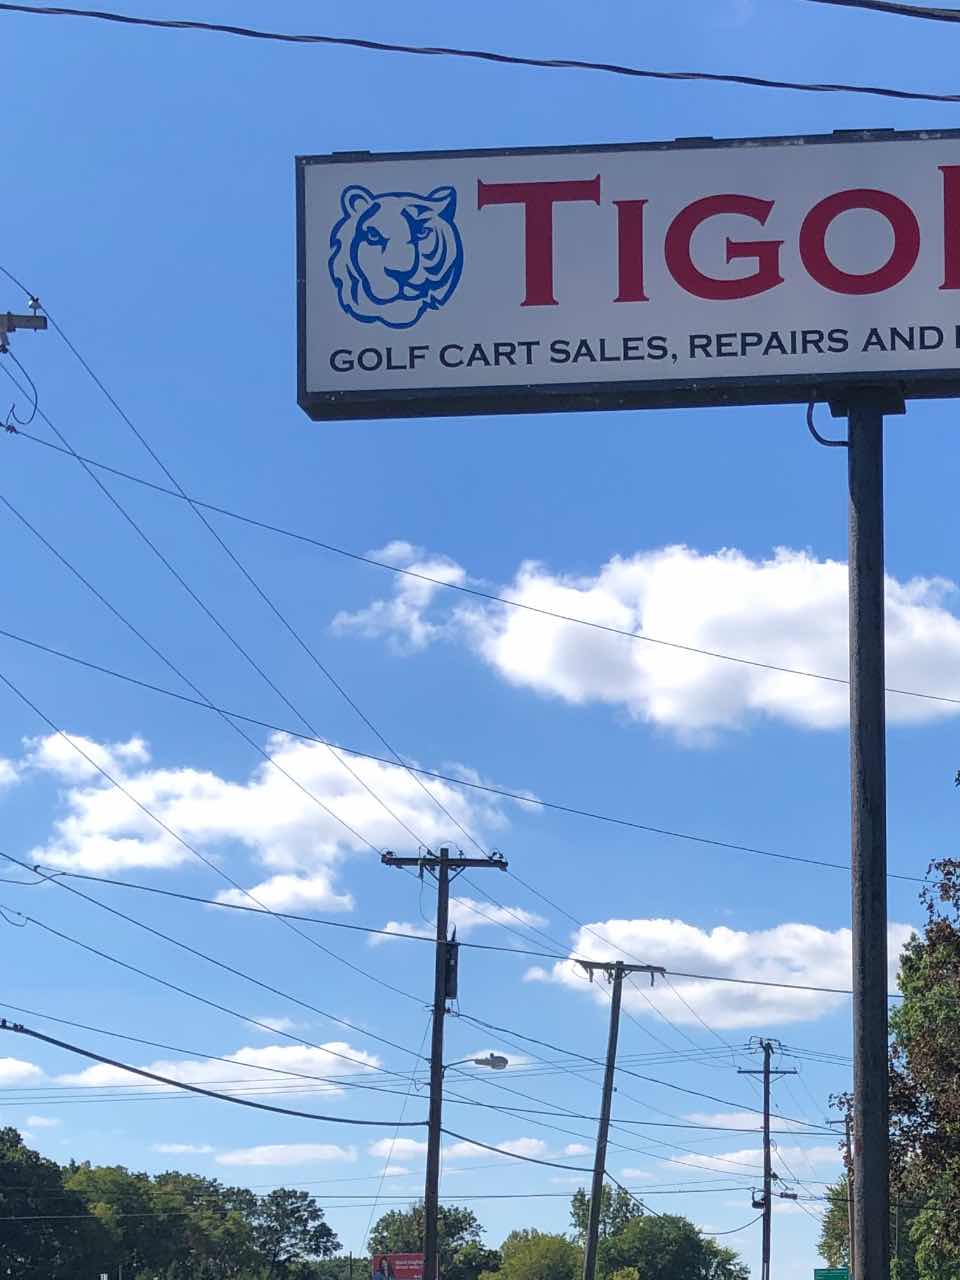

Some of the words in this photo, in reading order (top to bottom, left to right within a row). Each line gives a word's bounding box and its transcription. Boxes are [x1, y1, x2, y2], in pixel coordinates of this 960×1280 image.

[329, 345, 429, 372] GOLF
[439, 341, 540, 369] CART
[551, 336, 677, 365] SALES,
[690, 328, 848, 358] REPAIRS
[862, 324, 943, 352] AND
